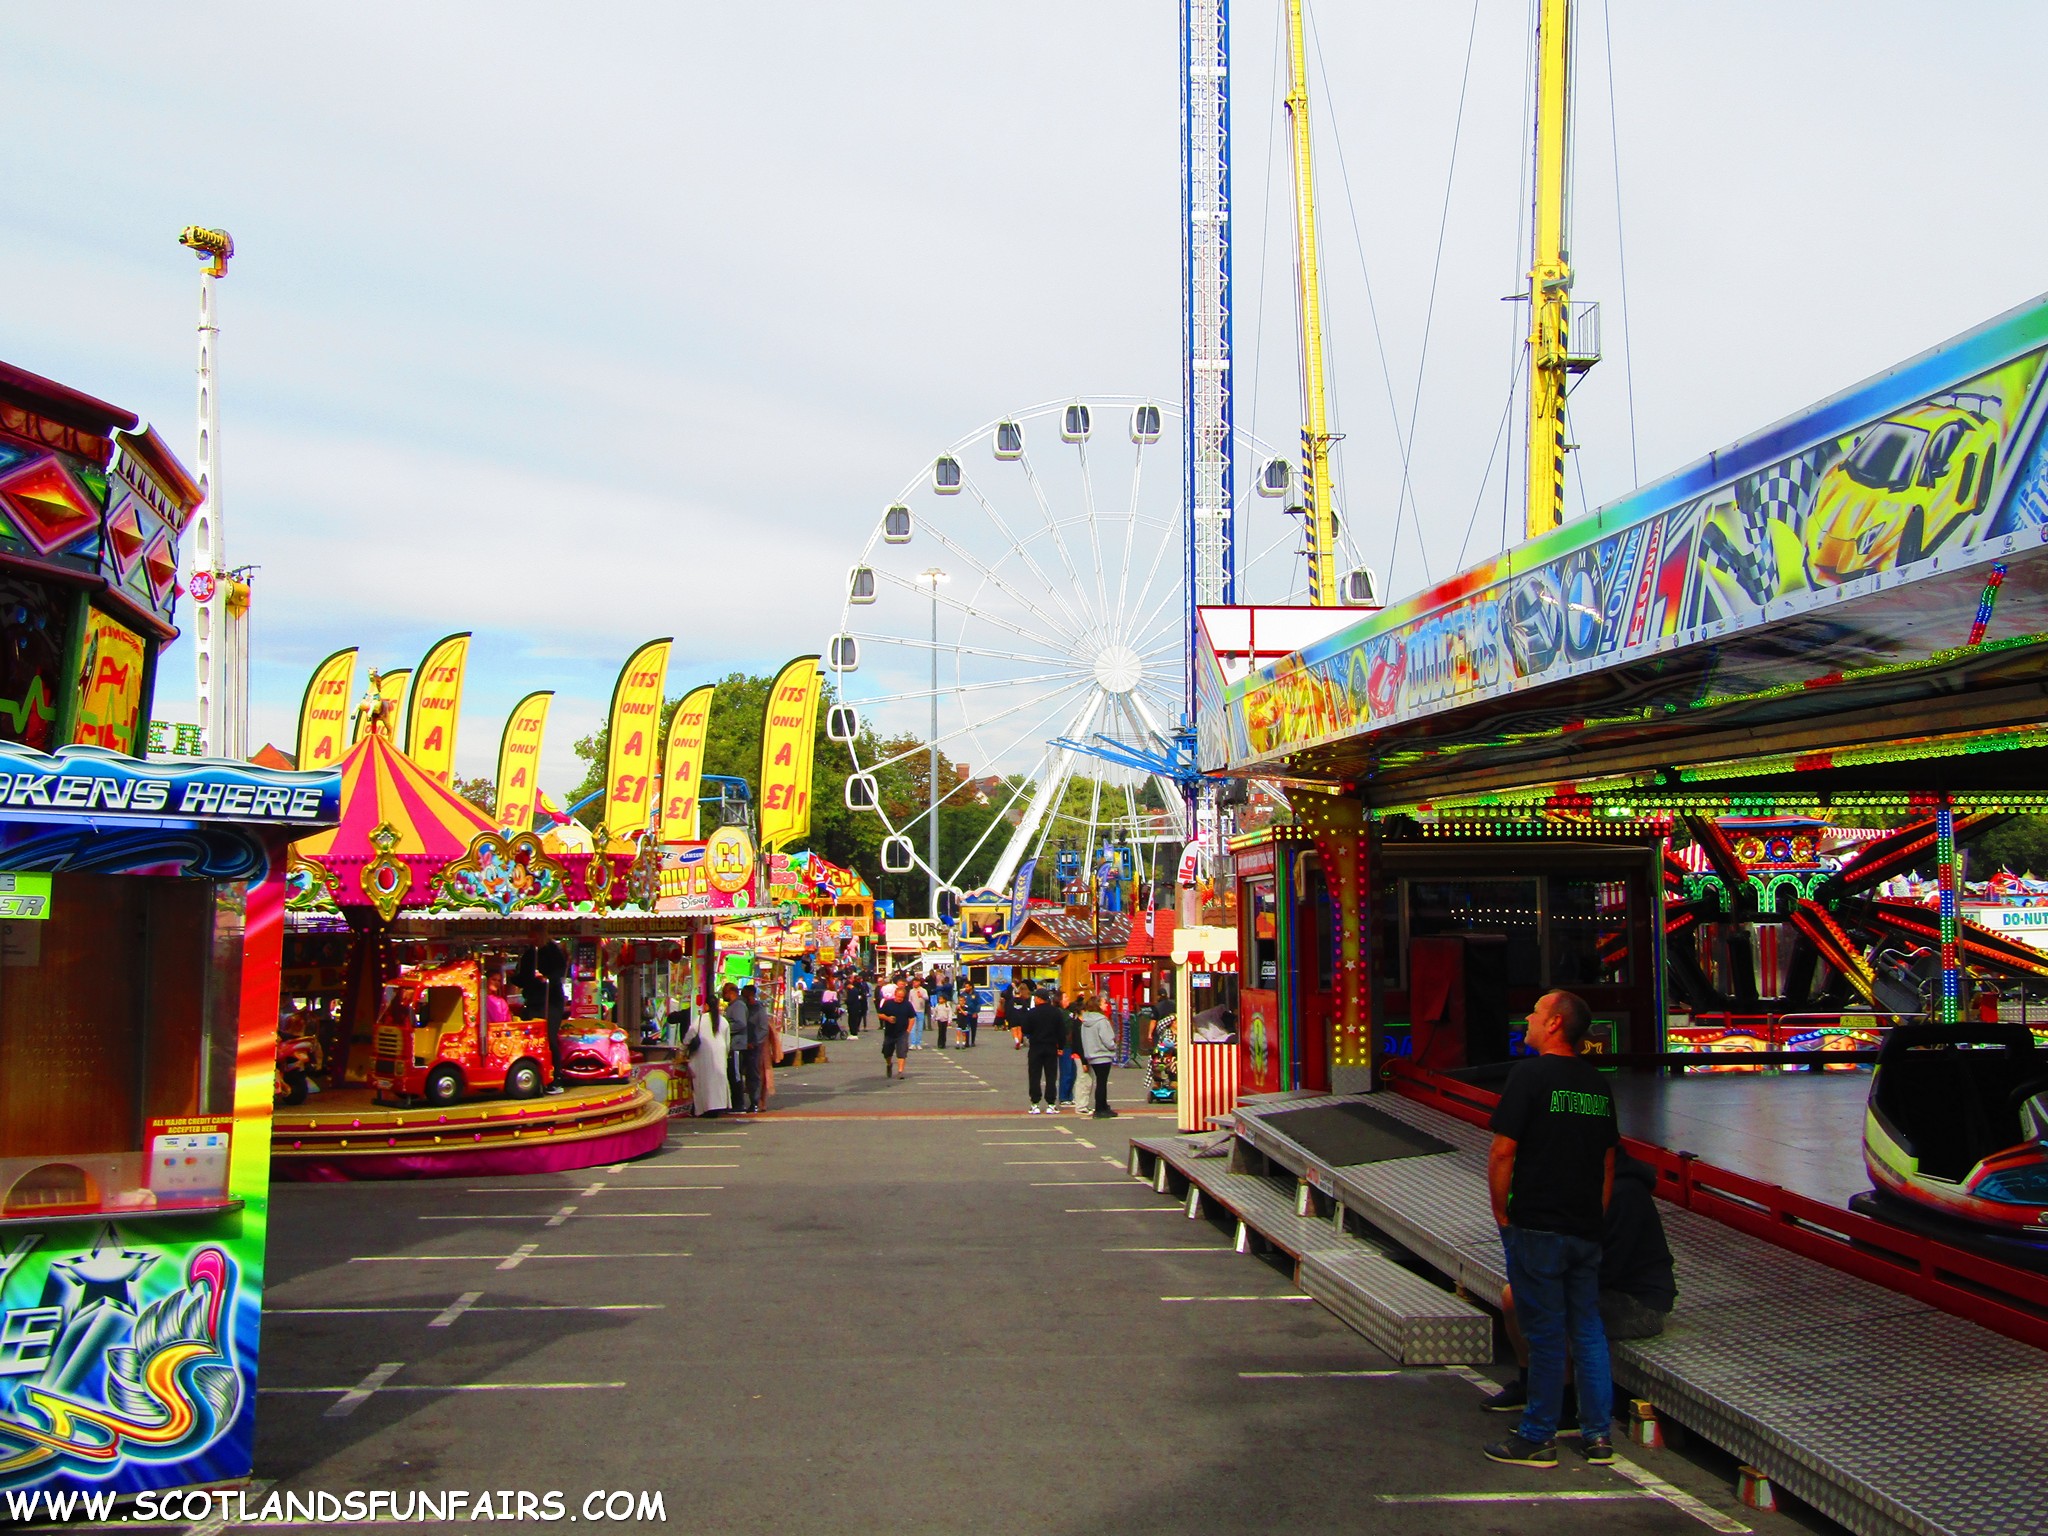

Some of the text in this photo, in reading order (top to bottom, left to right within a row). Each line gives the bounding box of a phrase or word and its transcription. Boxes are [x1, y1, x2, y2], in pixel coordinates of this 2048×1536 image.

[1601, 527, 1642, 651] PONTIAC
[1626, 518, 1663, 647] HONDA
[429, 667, 458, 683] ITS
[630, 672, 659, 688] ITS
[318, 680, 346, 695] ITS
[779, 686, 807, 703] ITS
[311, 709, 344, 721] ONLY
[421, 698, 455, 711] ONLY
[622, 703, 655, 716] ONLY
[516, 718, 541, 732] ITS
[679, 713, 704, 726] ITS
[771, 715, 803, 728] ONLY
[313, 736, 332, 759] A
[423, 726, 443, 751] A
[509, 743, 537, 754] ONLY
[624, 731, 643, 756] A
[673, 738, 701, 748] ONLY
[774, 742, 792, 766] A
[510, 767, 527, 788] A
[675, 760, 691, 781] A
[611, 774, 648, 803] £1
[763, 784, 795, 811] £1
[178, 781, 323, 818] HERE
[665, 797, 694, 819] £1
[499, 803, 530, 827] £1
[716, 842, 744, 874] £1
[660, 866, 708, 897] NLY A
[1550, 1090, 1611, 1117] ATTENDANT
[153, 1116, 233, 1127] ALL MAJOR CREDIT CARDS
[168, 1126, 201, 1134] ACCEPTED
